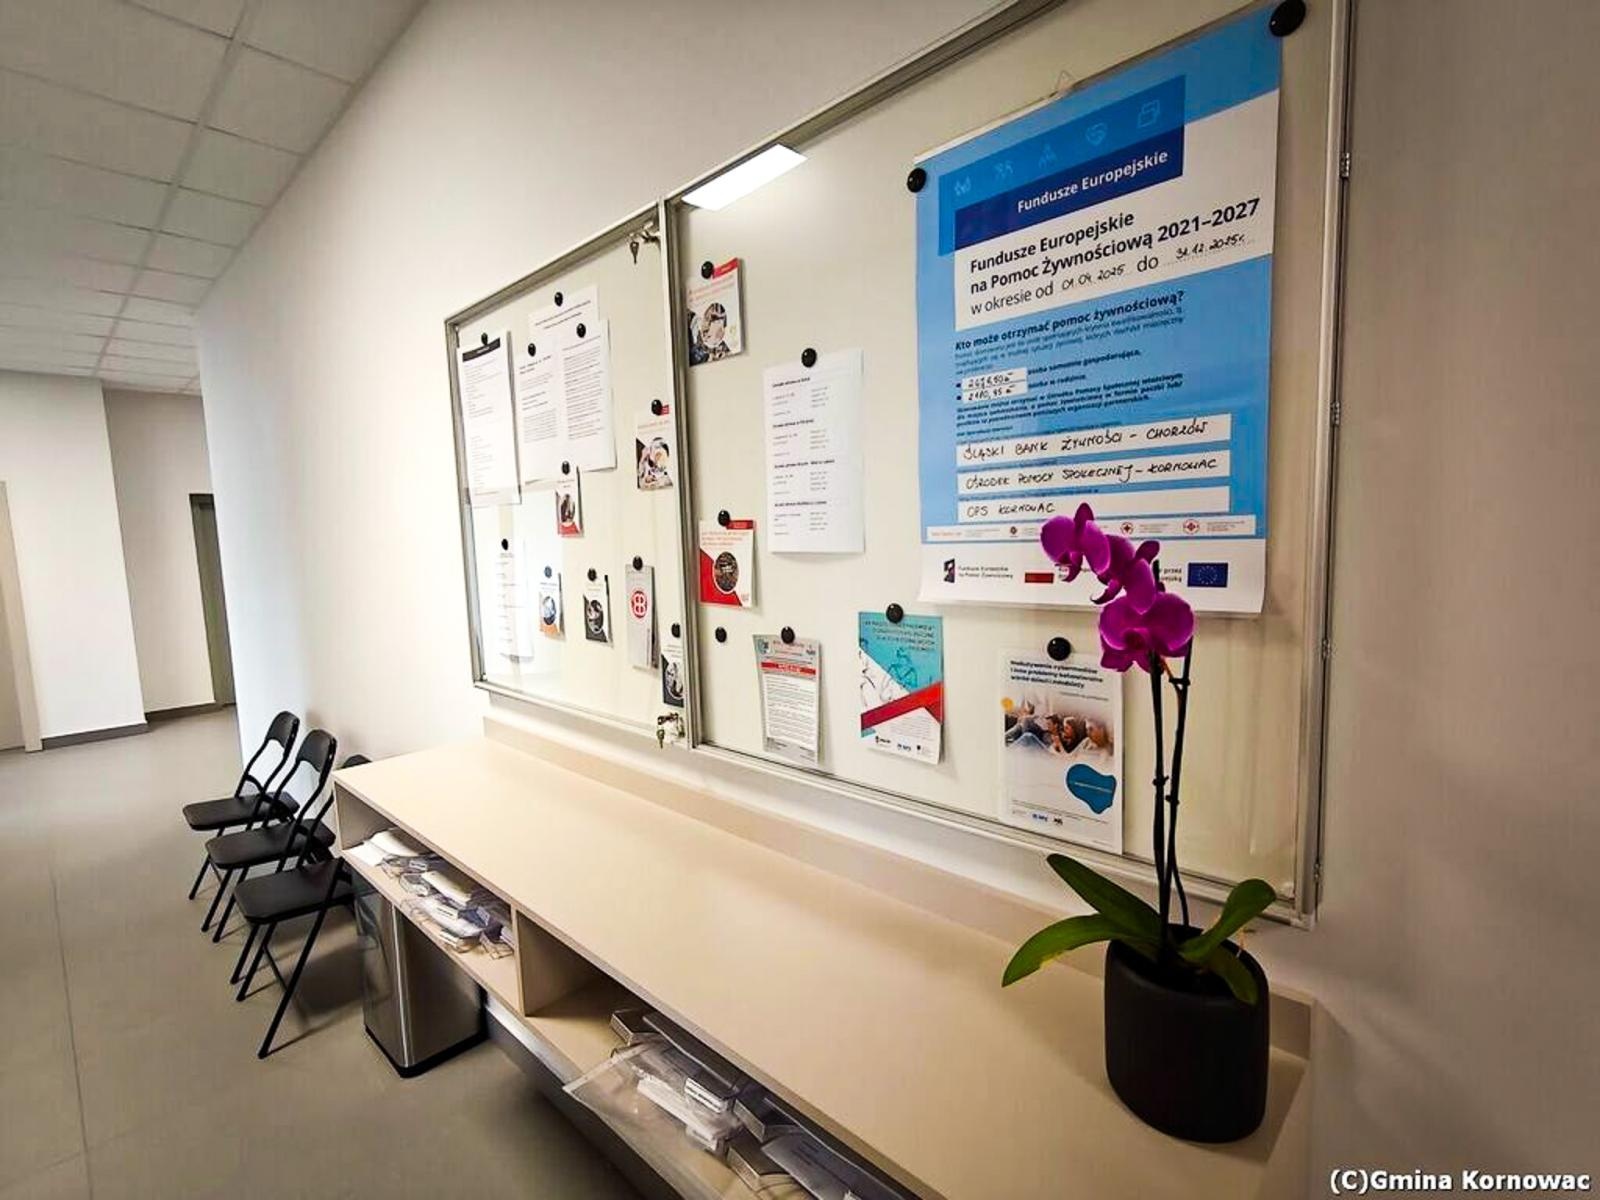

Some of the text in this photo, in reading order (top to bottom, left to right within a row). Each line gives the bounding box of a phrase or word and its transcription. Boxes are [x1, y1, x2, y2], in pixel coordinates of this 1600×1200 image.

[1017, 150, 1168, 213] Fundusze Europejskie
[970, 213, 1135, 273] Fundusze Europejskie
[970, 198, 1260, 295] na Pomoc Żywnościową 2021–2027
[1137, 256, 1158, 273] do
[955, 291, 1184, 351] Kto może otrzymać pomoc żywnościową?
[971, 282, 1054, 315] w okresie od
[1015, 441, 1048, 455] BANK
[1146, 418, 1208, 440] CHORZÓW
[967, 504, 988, 517] OPS
